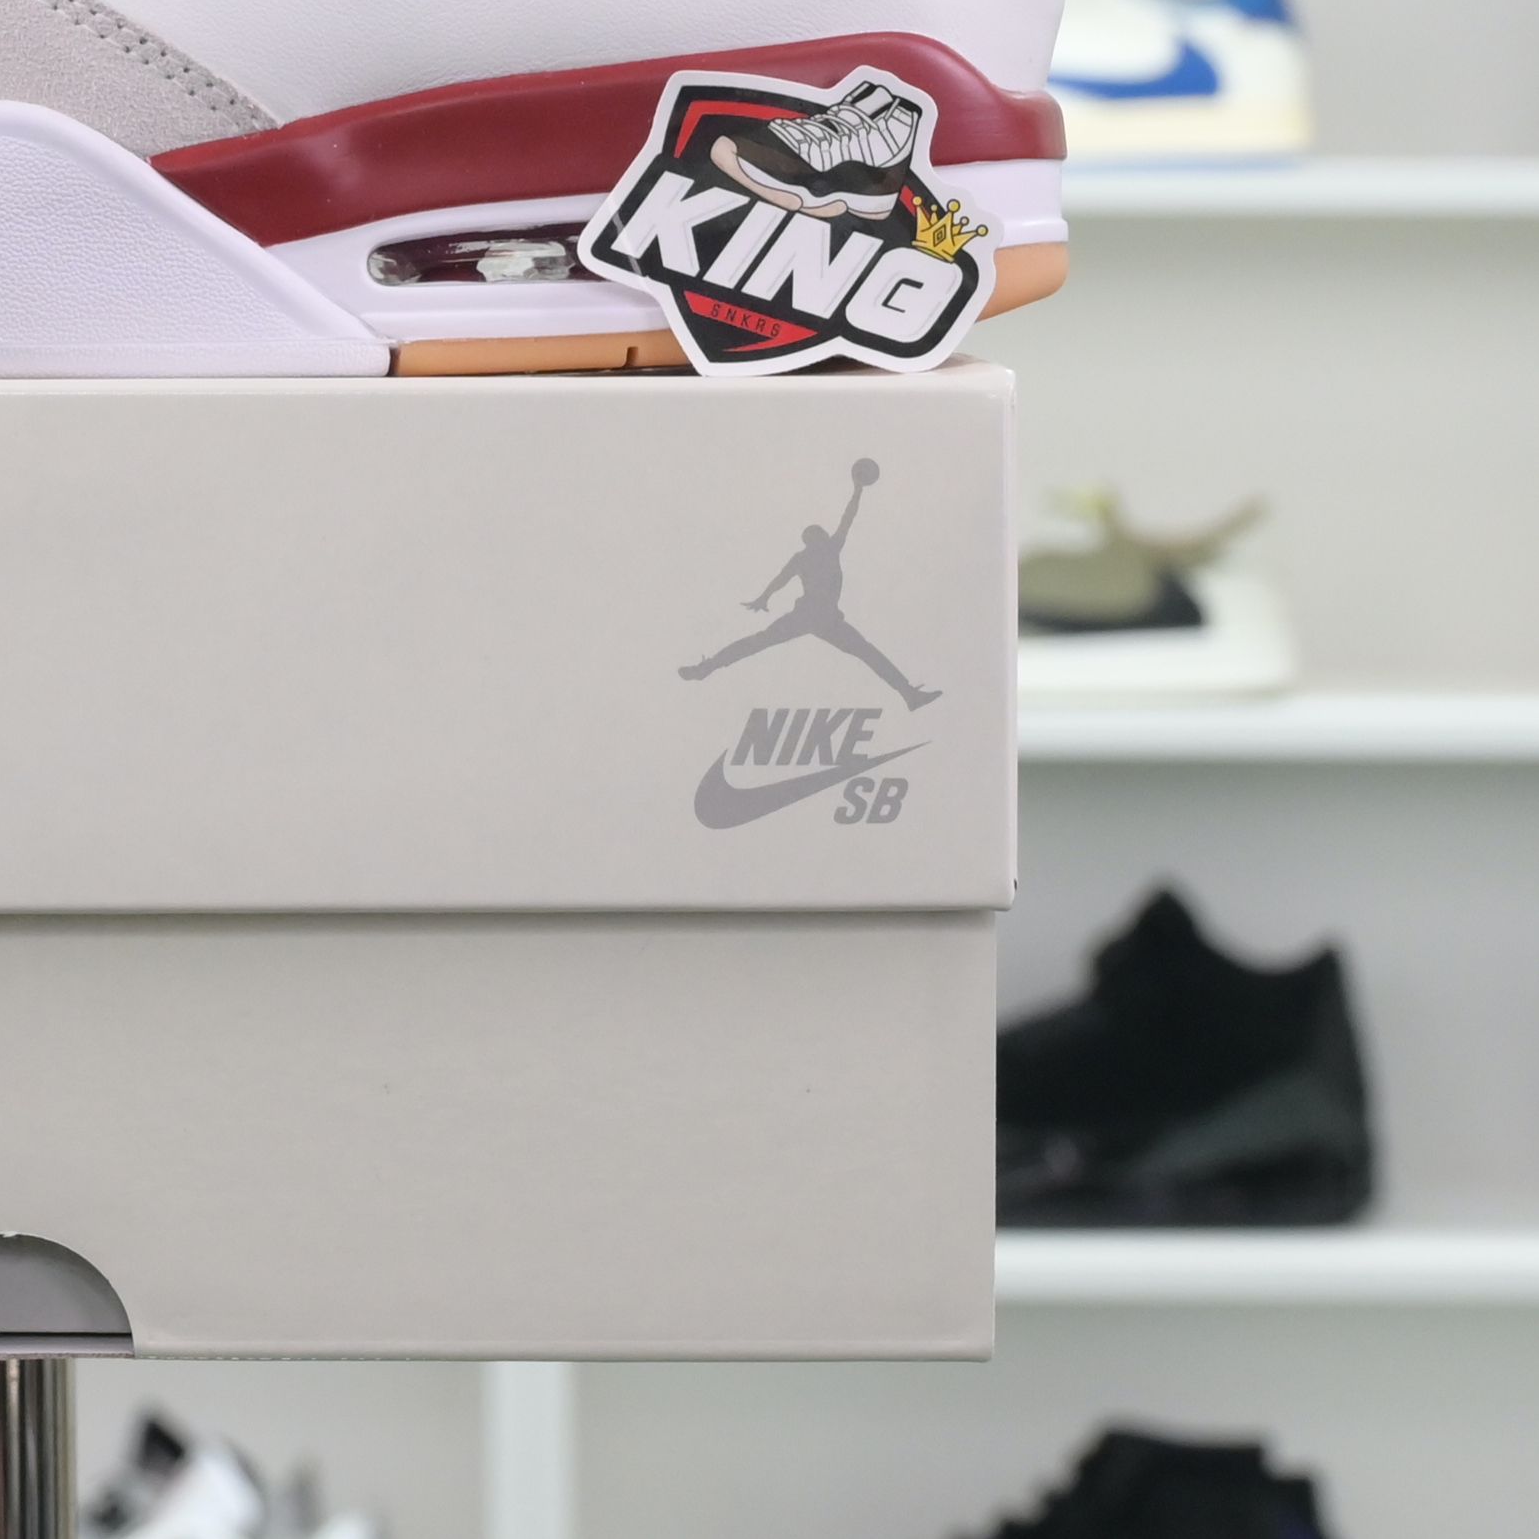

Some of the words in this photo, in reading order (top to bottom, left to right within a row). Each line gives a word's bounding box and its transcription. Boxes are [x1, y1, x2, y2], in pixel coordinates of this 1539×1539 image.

[610, 171, 963, 344] KING
[710, 303, 782, 337] SNKRS
[730, 707, 883, 767] NIKE
[833, 777, 908, 825] SB
